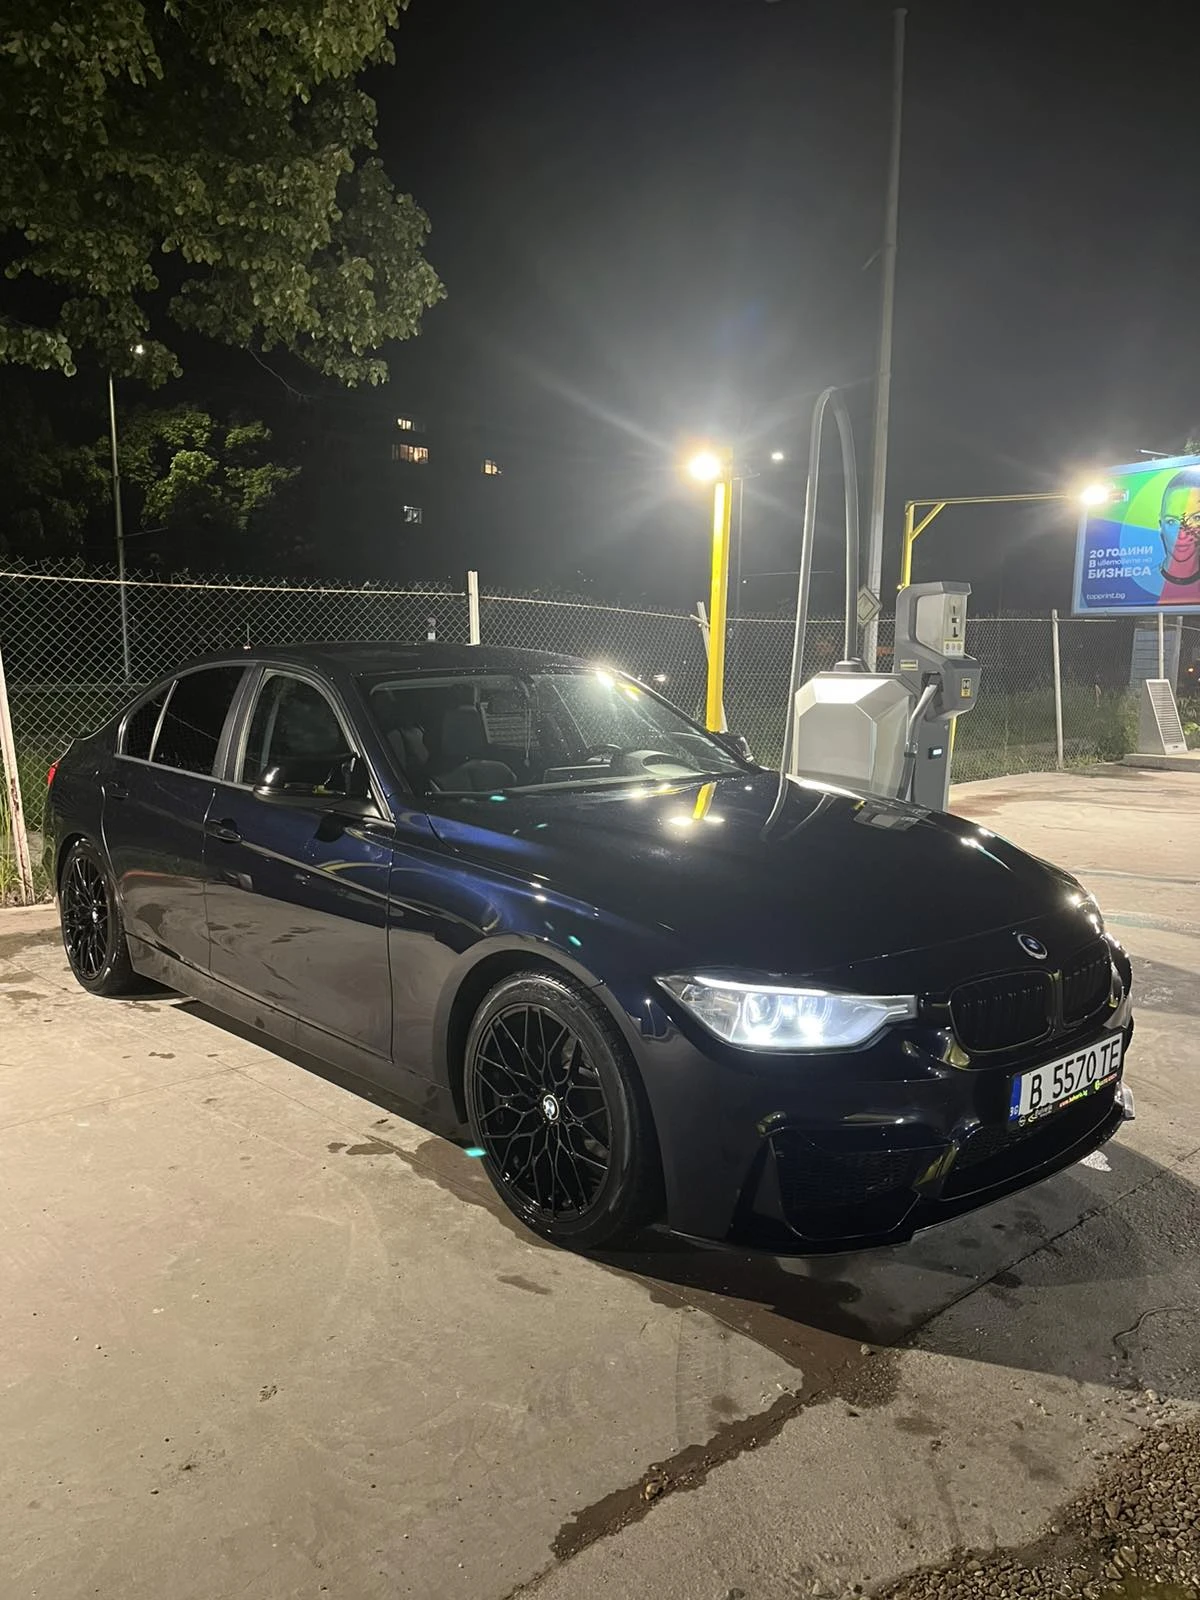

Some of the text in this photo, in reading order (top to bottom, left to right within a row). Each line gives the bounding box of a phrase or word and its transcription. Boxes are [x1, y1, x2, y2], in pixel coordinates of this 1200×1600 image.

[1090, 546, 1153, 558] 20 ГОДИНИ
[1088, 566, 1152, 579] БИЗНЕСА
[1030, 1074, 1042, 1110] B
[1052, 1050, 1097, 1099] 5570
[1100, 1039, 1120, 1076] TE
